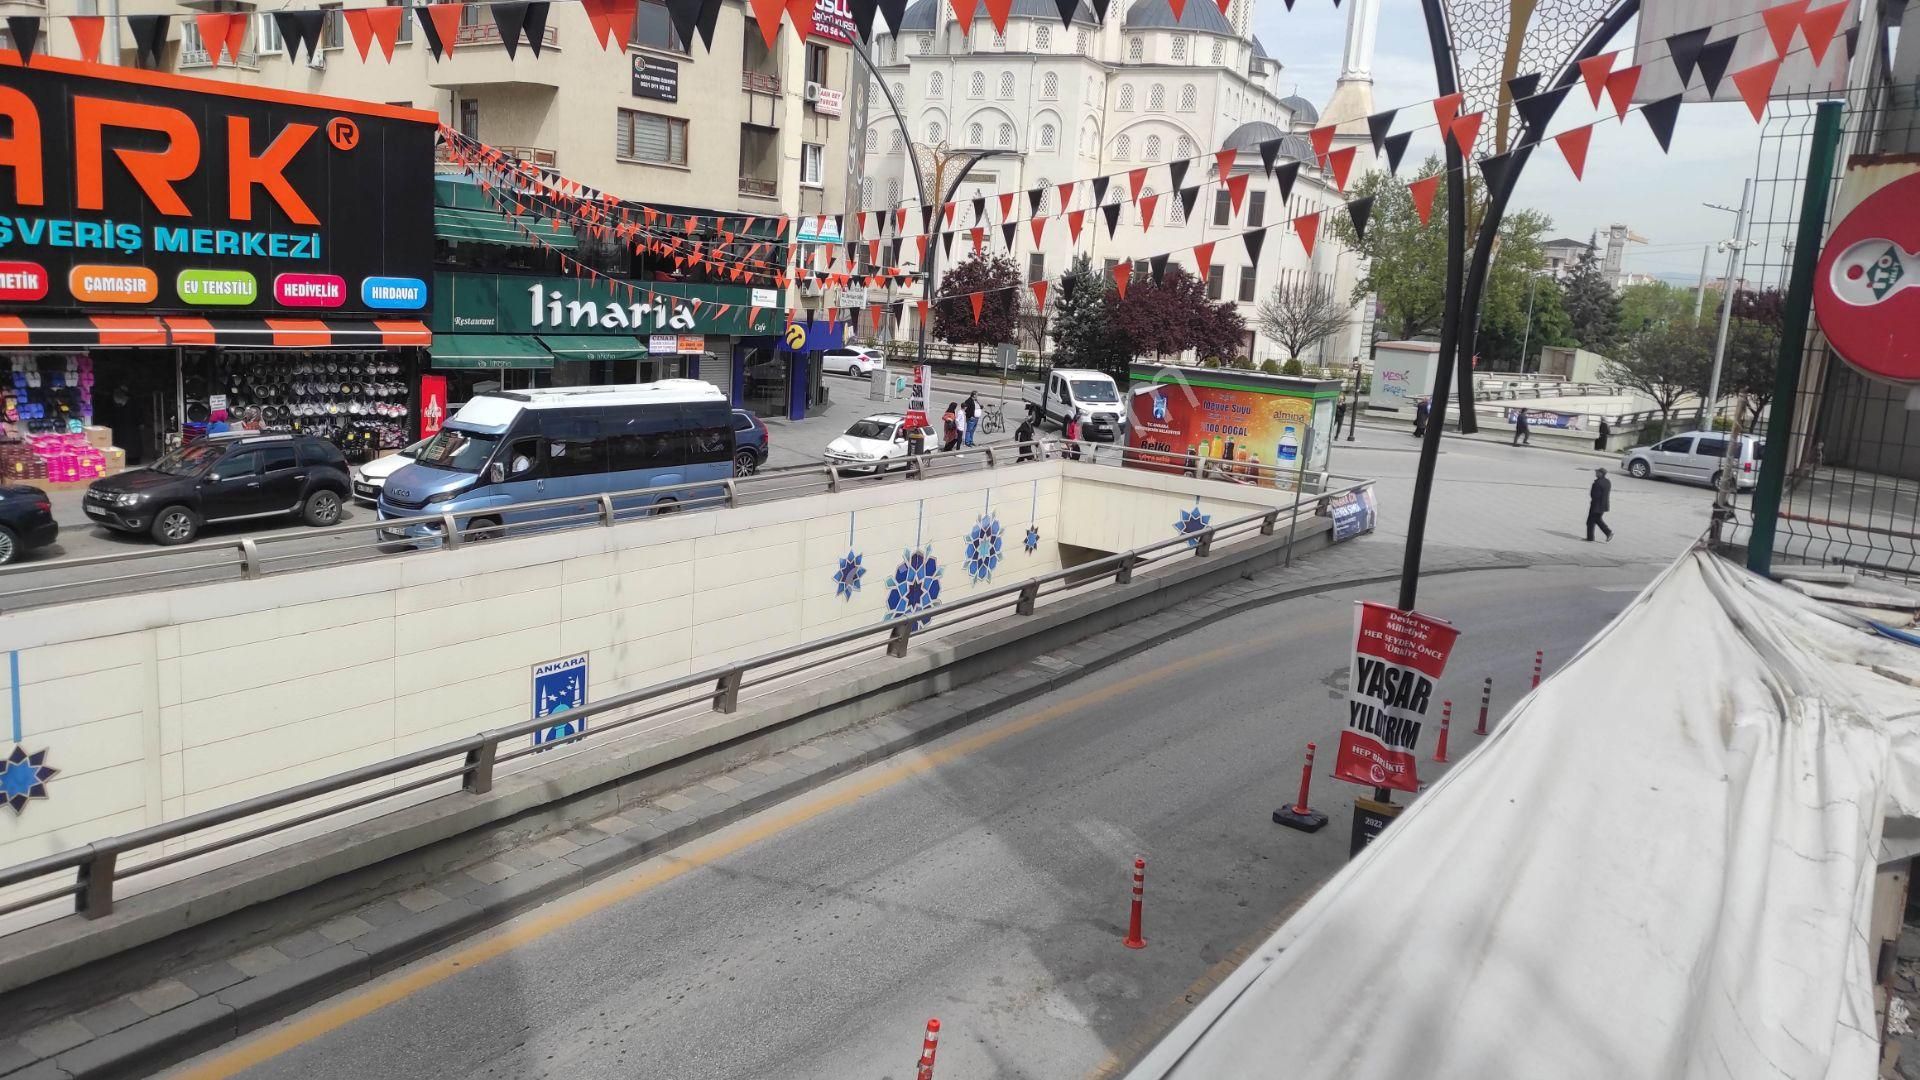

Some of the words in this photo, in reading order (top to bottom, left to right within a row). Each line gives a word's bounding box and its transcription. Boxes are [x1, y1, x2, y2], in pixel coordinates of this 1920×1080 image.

[815, 23, 828, 32] 270
[154, 226, 321, 260] MERKEZİ
[84, 276, 147, 295] ÇAMAŞIR
[184, 280, 199, 294] EV
[202, 279, 252, 295] TEKSTİLİ
[284, 281, 339, 298] HEDİYELİK
[372, 286, 419, 300] HIRDAVAT
[527, 283, 700, 330] linaria
[454, 316, 495, 326] Restaurant
[1386, 621, 1428, 641] Milletiyle
[1389, 612, 1418, 627] Devlet
[1420, 623, 1430, 632] ve
[1364, 629, 1383, 640] HER
[1418, 644, 1444, 660] ÖNCE
[536, 656, 586, 675] ANKARA
[1357, 656, 1433, 715] YAŞAR
[1349, 700, 1422, 750] YILDIRIM
[1352, 745, 1372, 757] HEP
[1372, 752, 1406, 774] BİRLİKTE
